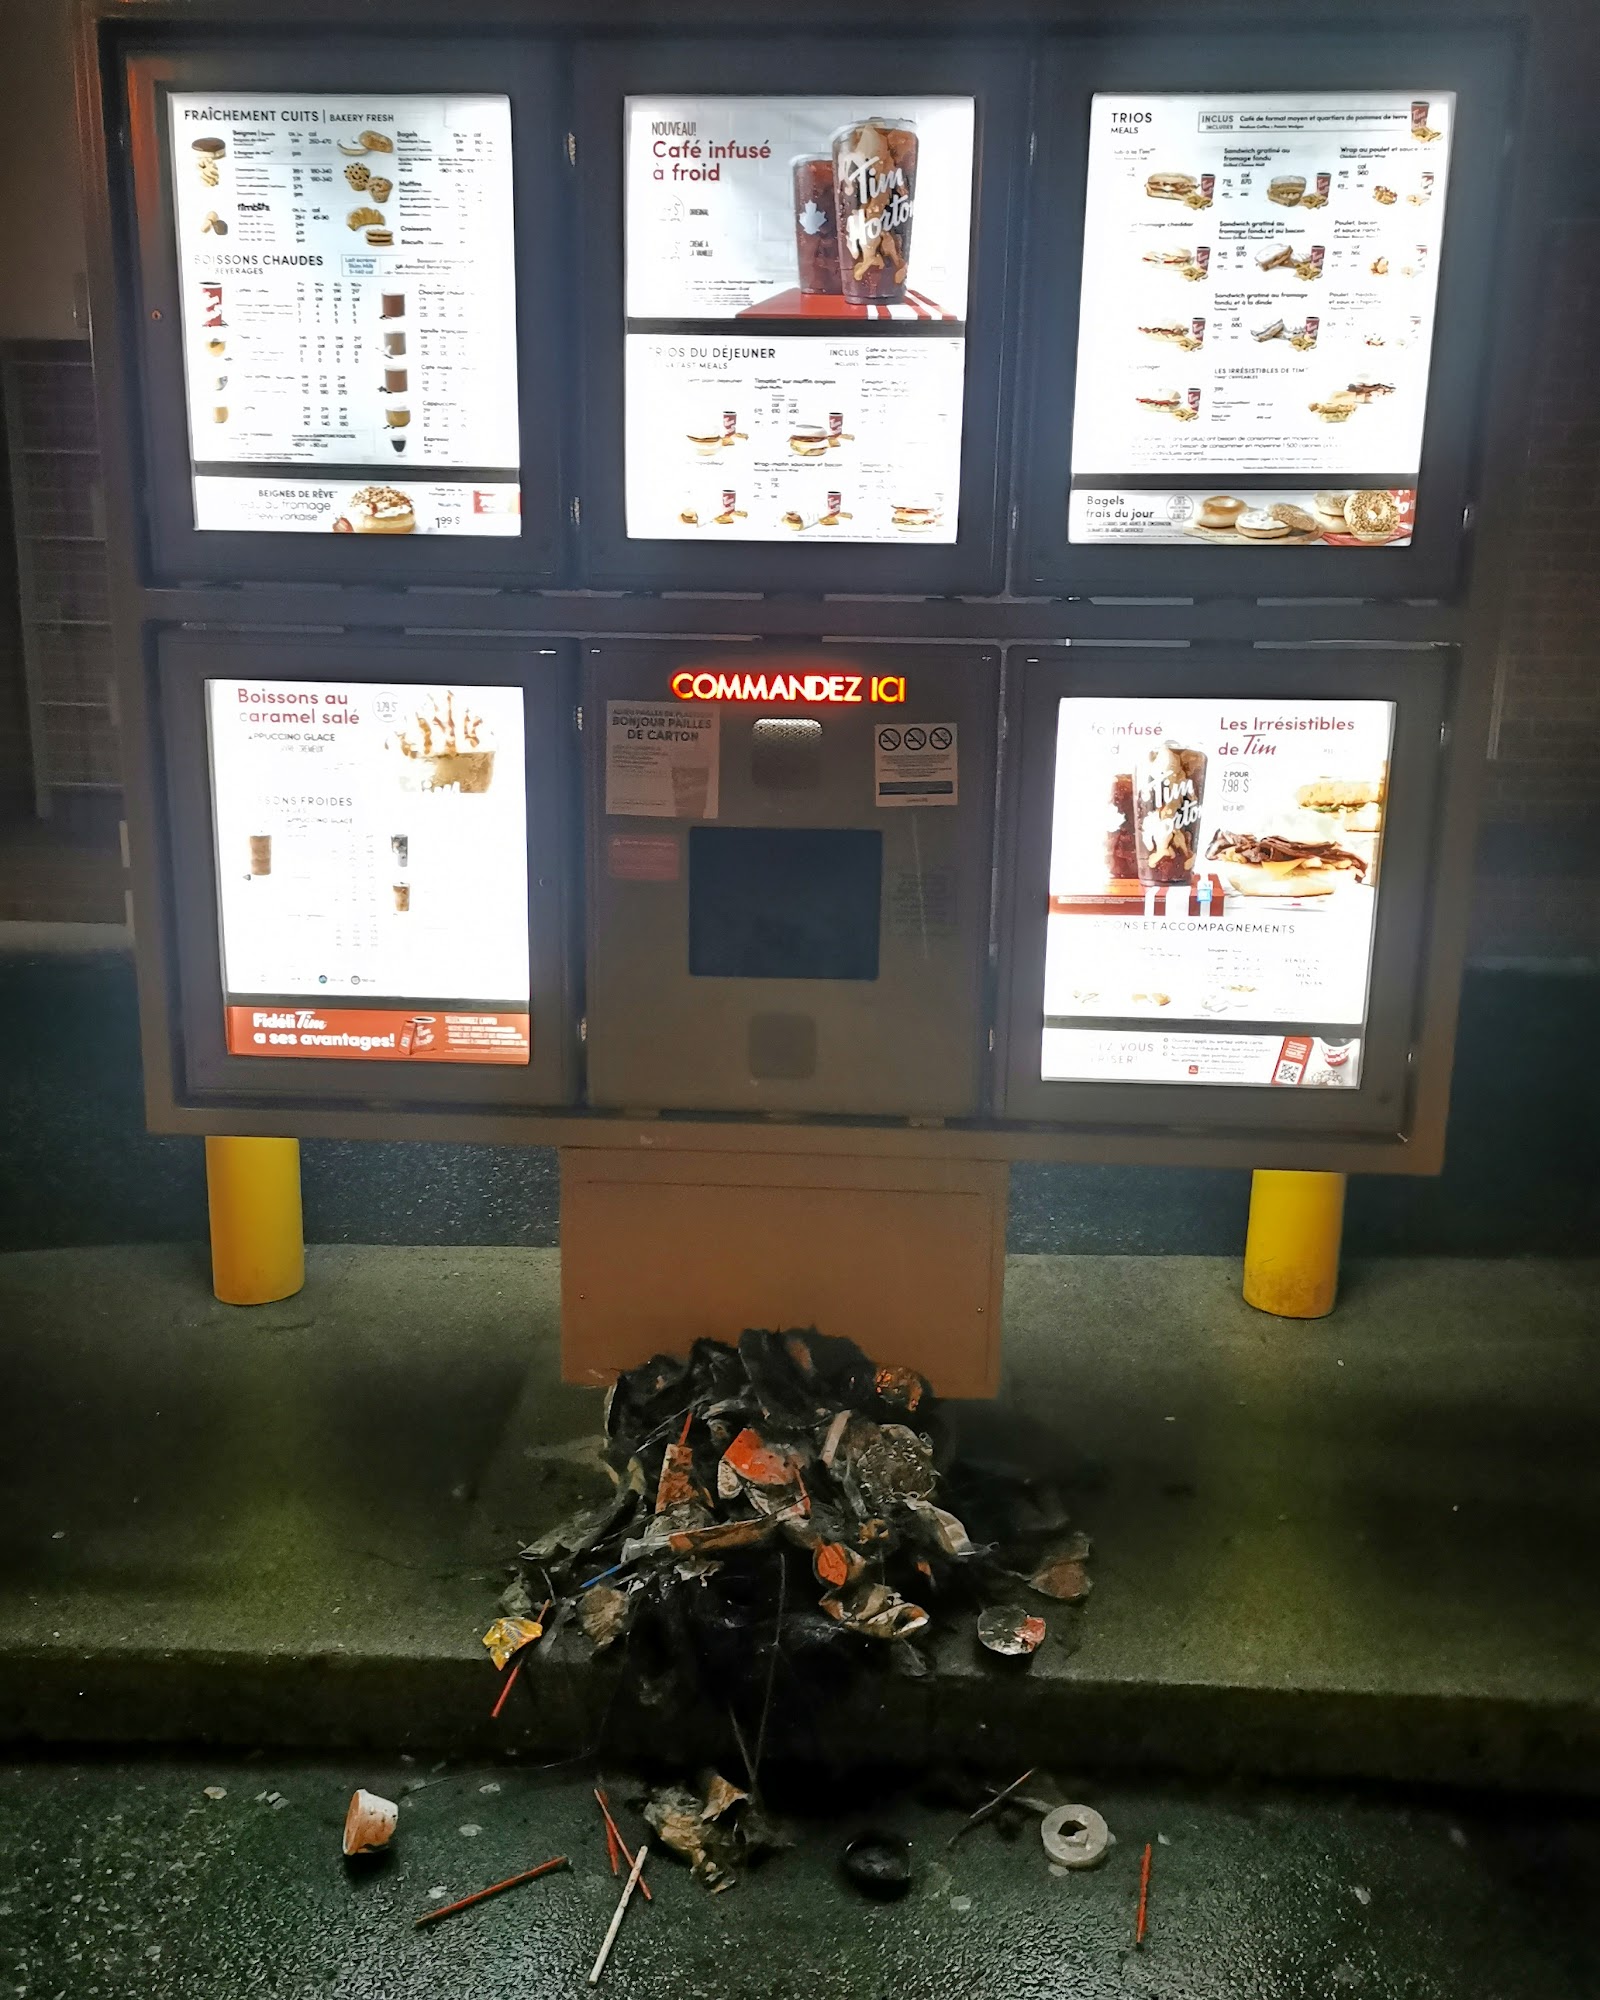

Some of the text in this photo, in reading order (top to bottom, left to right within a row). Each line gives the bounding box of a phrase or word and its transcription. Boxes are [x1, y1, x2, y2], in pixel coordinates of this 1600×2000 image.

[184, 105, 395, 122] FRAÎCHEMENT CUITS BAKERY FRESH
[1110, 112, 1152, 124] TRIOS
[1201, 115, 1235, 123] INCLUS
[397, 131, 418, 139] Bagels
[651, 121, 697, 137] NOUVEAU!
[652, 139, 771, 159] Café infusé
[1256, 146, 1281, 156] gratiné
[1368, 146, 1391, 154] poulet
[1223, 155, 1251, 163] fromage
[652, 162, 721, 182] à froid
[1251, 220, 1275, 229] gratiné
[1218, 228, 1246, 237] fromage
[263, 255, 324, 266] CHAUDES
[1280, 292, 1308, 300] fromage
[690, 347, 708, 358] DU
[712, 345, 777, 361] DÉJEUNER
[829, 349, 860, 357] INCLUS
[699, 361, 728, 369] MEALS
[1228, 366, 1279, 374] IRRÉSISTIBLES
[258, 489, 296, 498] BEIGNES
[298, 490, 310, 499] DE
[1086, 495, 1125, 508] Bagels
[1086, 508, 1154, 521] frais du jour
[671, 672, 906, 703] COMMANDEZ ICI
[237, 687, 349, 705] Boissons au
[239, 707, 361, 725] caramel salé
[612, 716, 712, 730] BONJOUR PAILLES
[1111, 721, 1163, 736] infusé
[1220, 716, 1355, 731] Les Irrésistibles
[627, 729, 699, 742] DE CARTON
[1217, 733, 1277, 756] de Tim
[1221, 778, 1239, 793] 7.98
[301, 796, 353, 807] FROIDES
[1143, 921, 1158, 931] ET
[1159, 921, 1295, 934] ACCOMPAGNEMENTS
[252, 1032, 396, 1051] a ses avantages!
[1120, 1042, 1155, 1053] VOUS
